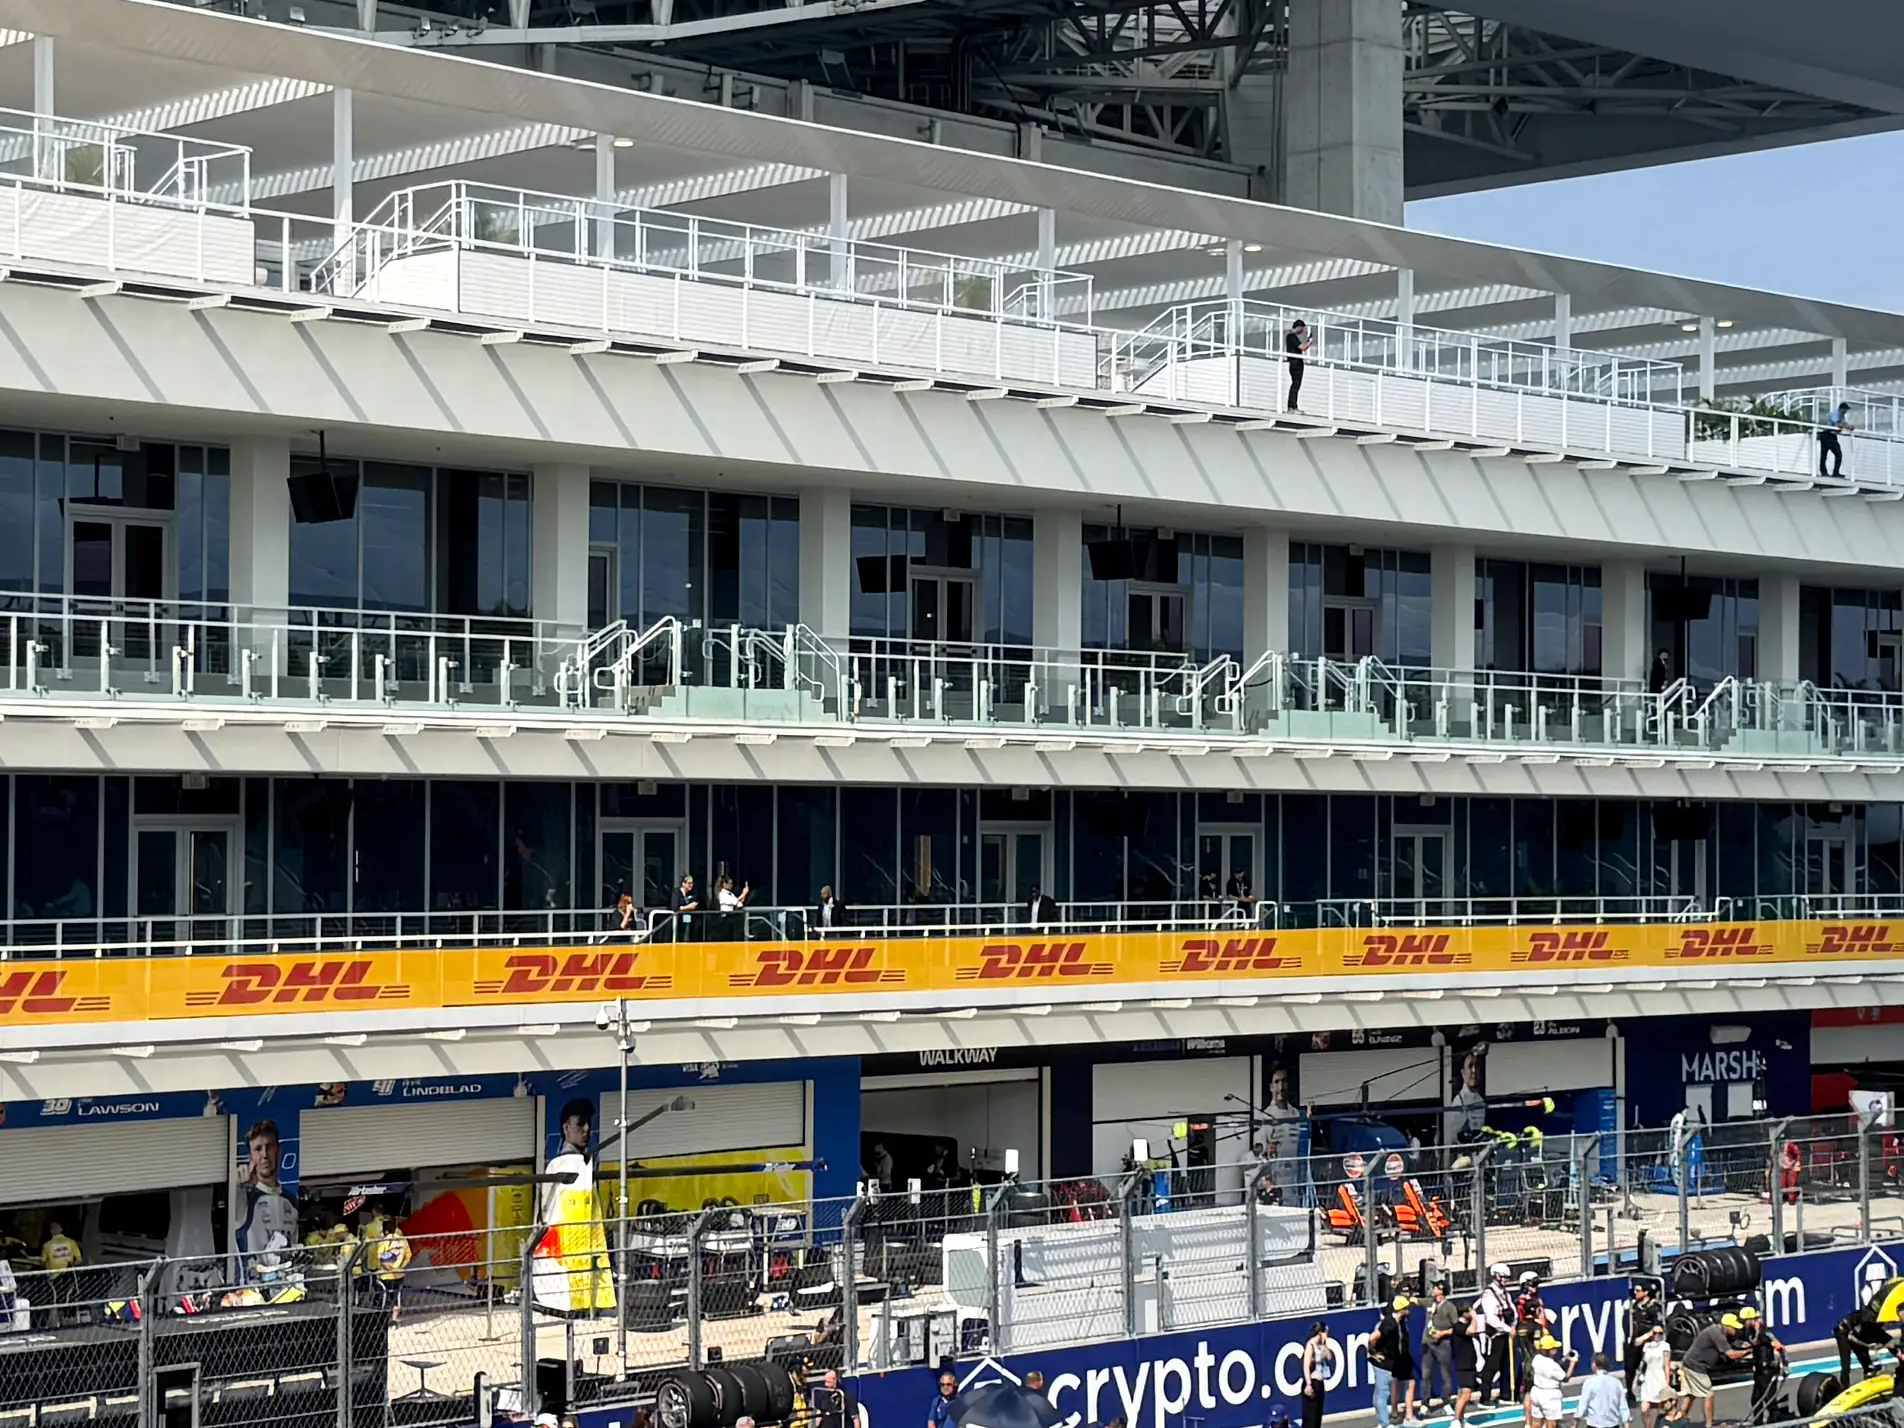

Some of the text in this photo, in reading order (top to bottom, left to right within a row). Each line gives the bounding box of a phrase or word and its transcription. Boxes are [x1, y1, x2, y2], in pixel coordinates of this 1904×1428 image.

[1173, 937, 1285, 973] DHL
[1360, 934, 1456, 967] DHL
[1526, 931, 1614, 962] DHL
[1679, 928, 1760, 958] DHL
[1819, 925, 1894, 954] DHL
[500, 952, 648, 994] DHL
[753, 947, 881, 986] DHL
[978, 942, 1095, 980] DHL
[217, 960, 382, 1006] DHL
[919, 1047, 999, 1067] WALKWAY
[1681, 1049, 1757, 1083] MARSH
[402, 1083, 482, 1098] LINDBLAD
[77, 1101, 160, 1117] LAWSON
